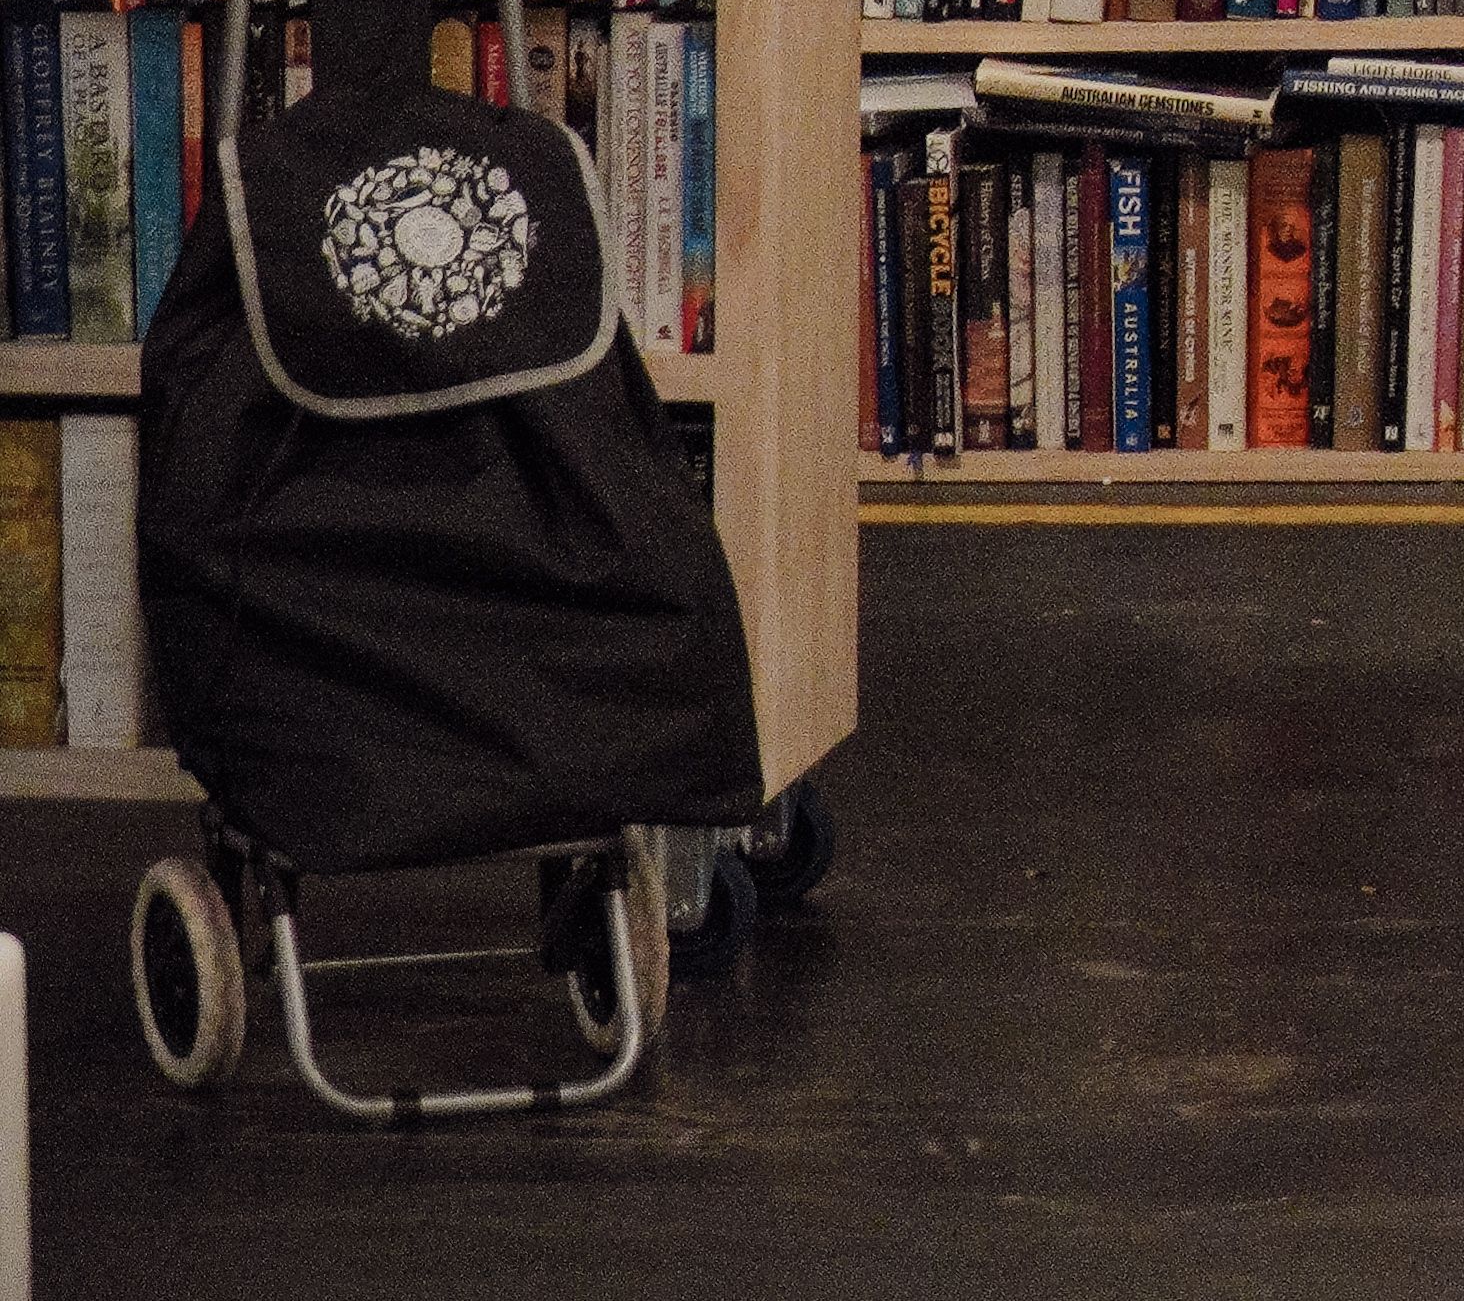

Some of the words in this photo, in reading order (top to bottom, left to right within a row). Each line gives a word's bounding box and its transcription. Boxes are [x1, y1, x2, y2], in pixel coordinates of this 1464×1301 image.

[927, 186, 951, 297] BICYCLE
[1114, 169, 1143, 236] FISH
[1123, 301, 1139, 420] AUSTRALIA
